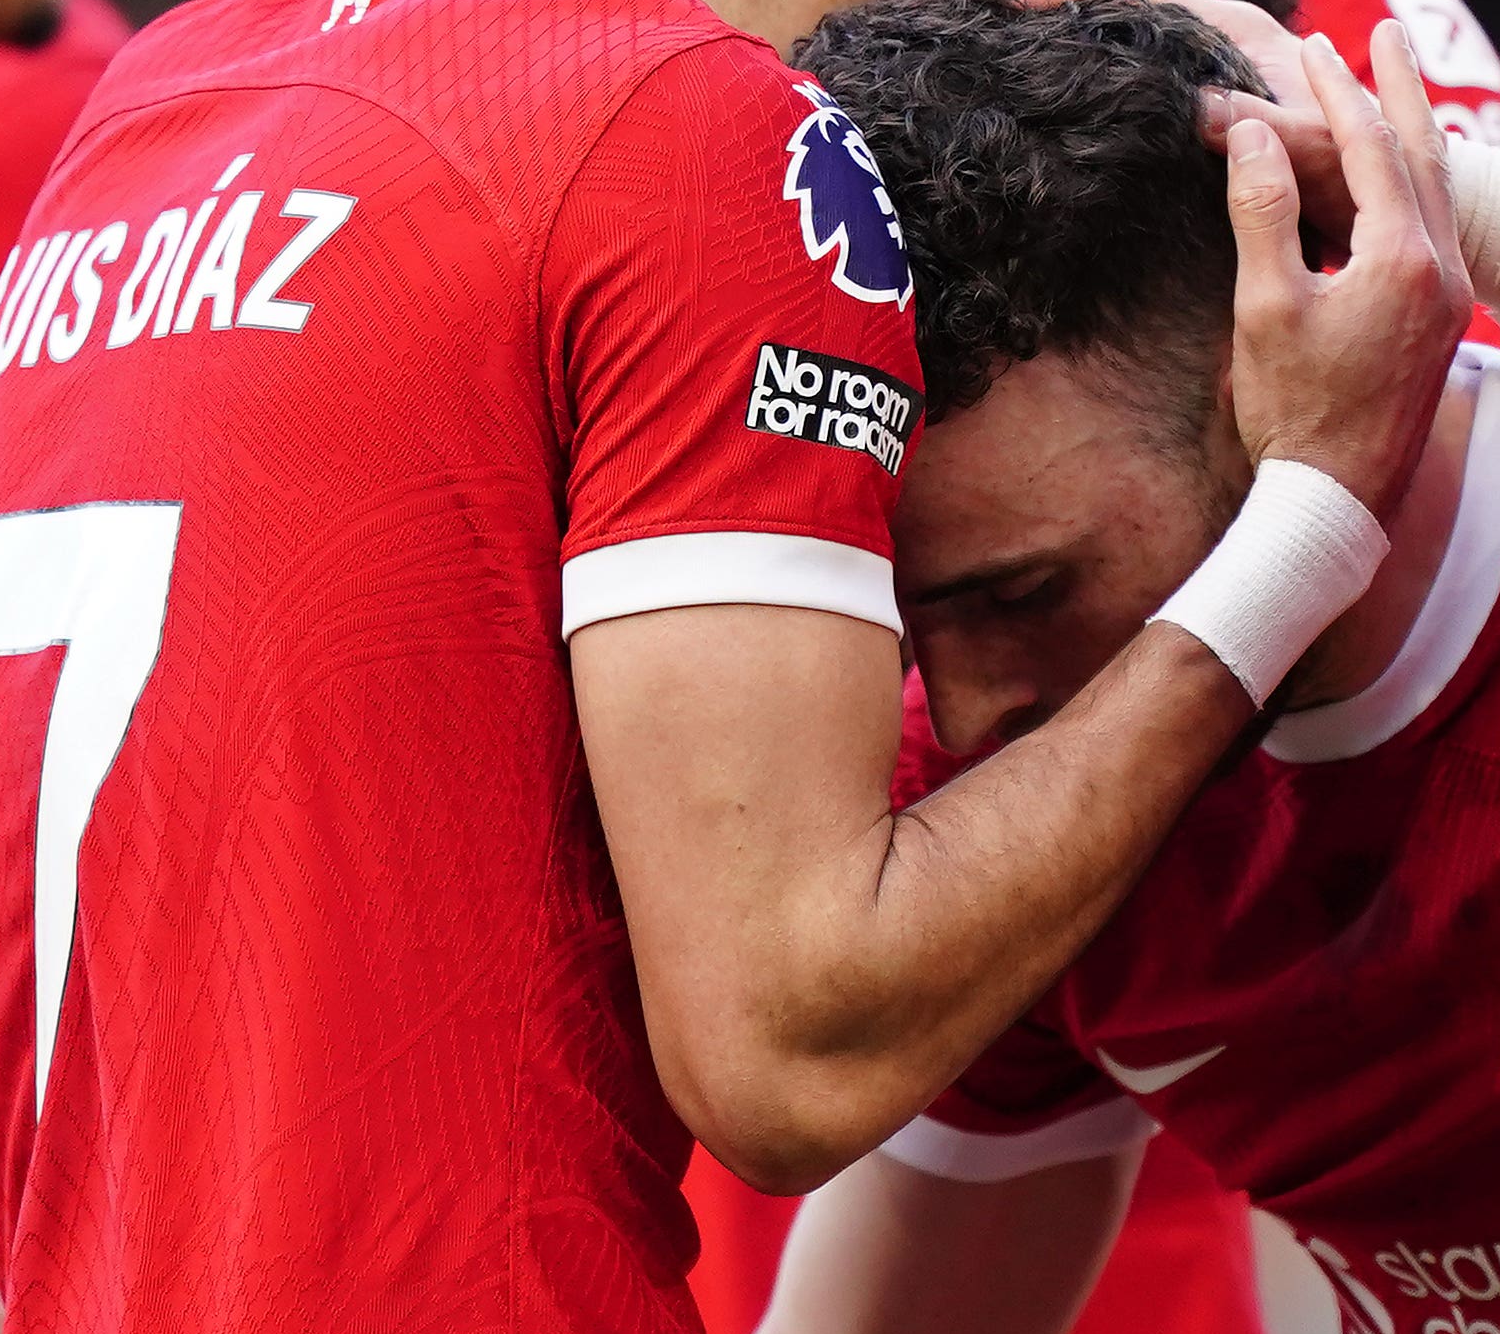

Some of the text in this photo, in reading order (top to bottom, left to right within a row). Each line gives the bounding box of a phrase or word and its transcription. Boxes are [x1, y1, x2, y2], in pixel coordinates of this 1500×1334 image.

[105, 152, 359, 350] DÍAZ
[746, 385, 905, 476] for racism
[754, 344, 911, 433] No room
